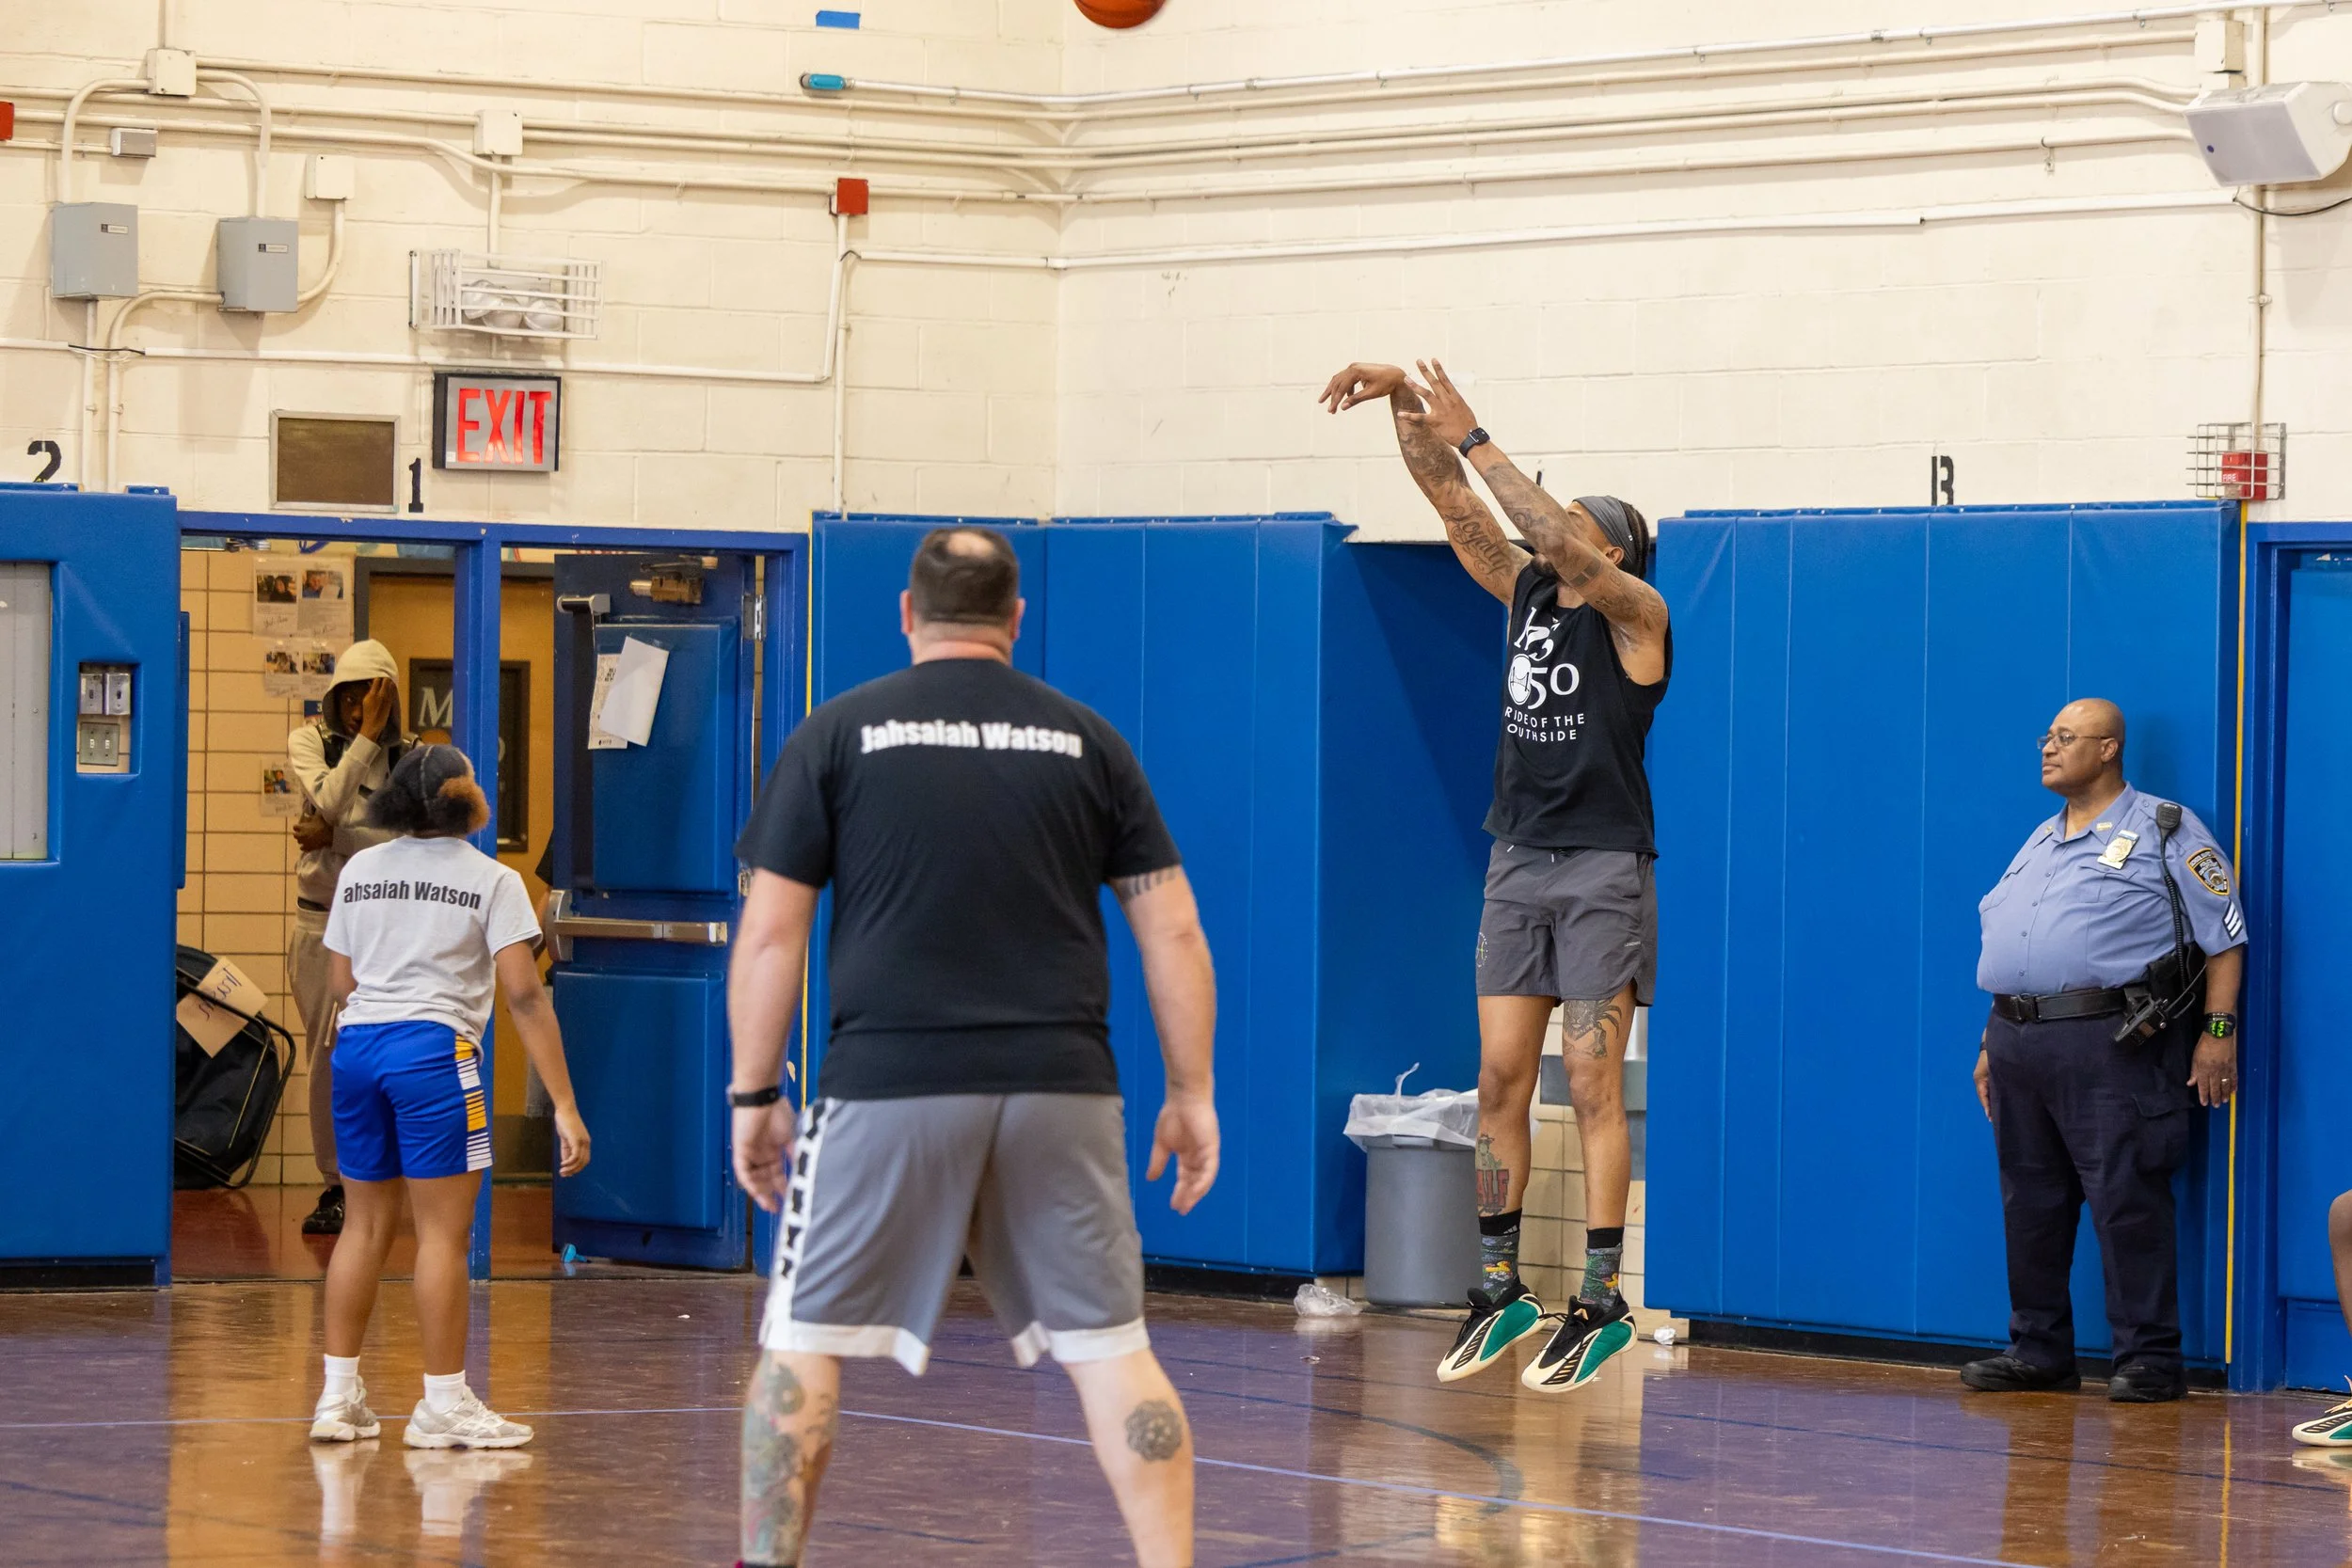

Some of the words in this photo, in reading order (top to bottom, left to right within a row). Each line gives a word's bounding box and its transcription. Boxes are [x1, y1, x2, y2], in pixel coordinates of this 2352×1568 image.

[456, 388, 552, 465] EXIT
[27, 440, 62, 483] 2
[408, 457, 424, 514] 1
[860, 719, 980, 754] Jahsaiah
[980, 721, 1083, 759] Watson
[1530, 717, 1548, 729] OF
[1553, 713, 1585, 727] THE
[414, 880, 482, 910] Watson
